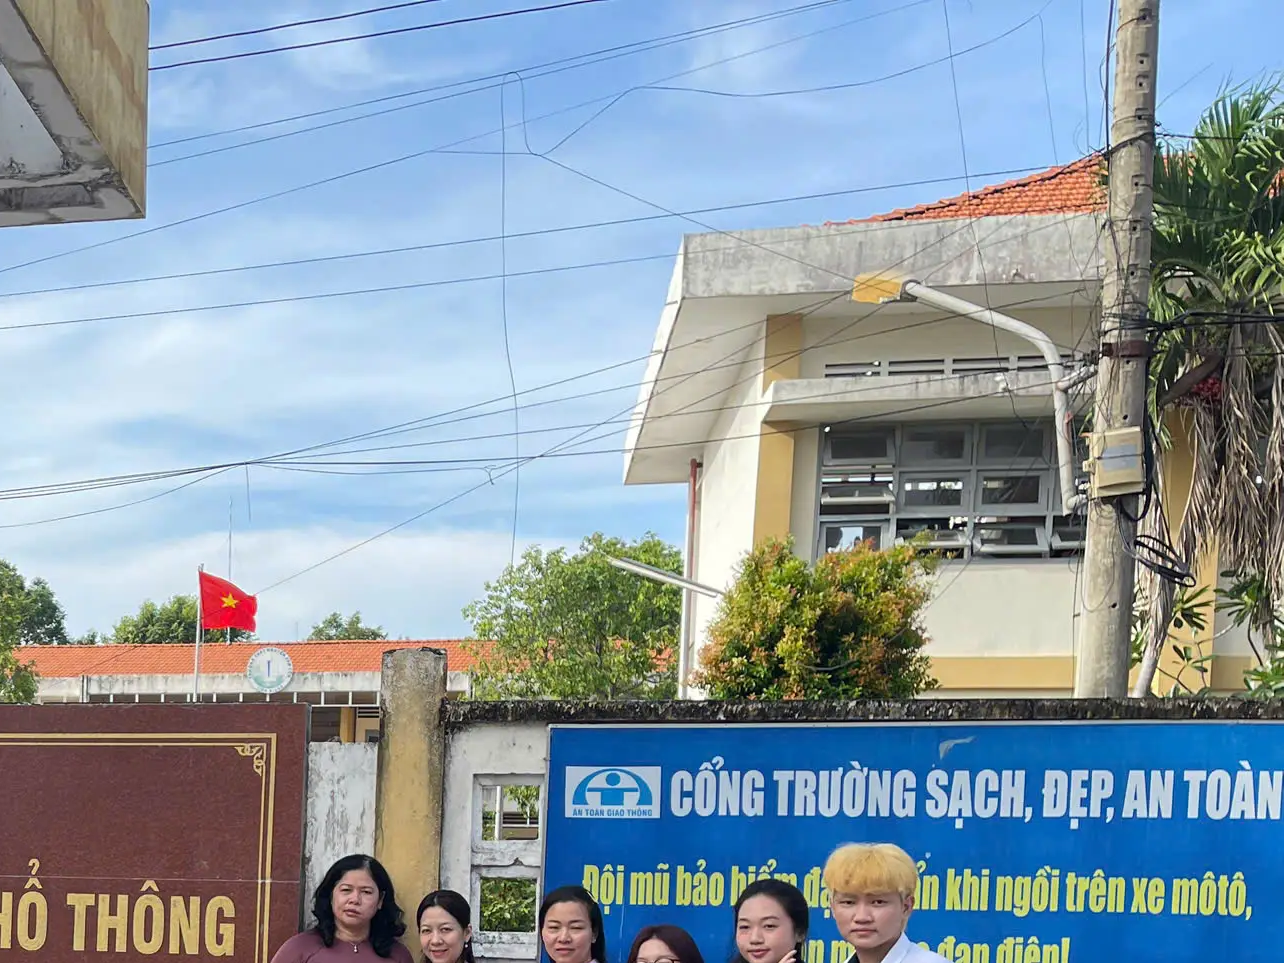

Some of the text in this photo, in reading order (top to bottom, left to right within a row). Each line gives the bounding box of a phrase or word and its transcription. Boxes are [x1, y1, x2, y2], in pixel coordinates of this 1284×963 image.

[606, 807, 625, 817] GIAO
[670, 755, 1283, 830] CỔNG TRƯỜNG SẠCH, ĐẸP, AN TOÀN
[66, 879, 236, 957] THÔNG
[582, 864, 625, 915] Đội
[630, 863, 670, 905] mũ
[676, 858, 725, 907] bảo
[803, 866, 832, 919] đạ
[945, 868, 991, 911] khi
[995, 865, 1060, 918] ngồi
[1065, 869, 1126, 914] trên
[1129, 876, 1165, 914] xe
[1171, 871, 1253, 921] môtô,
